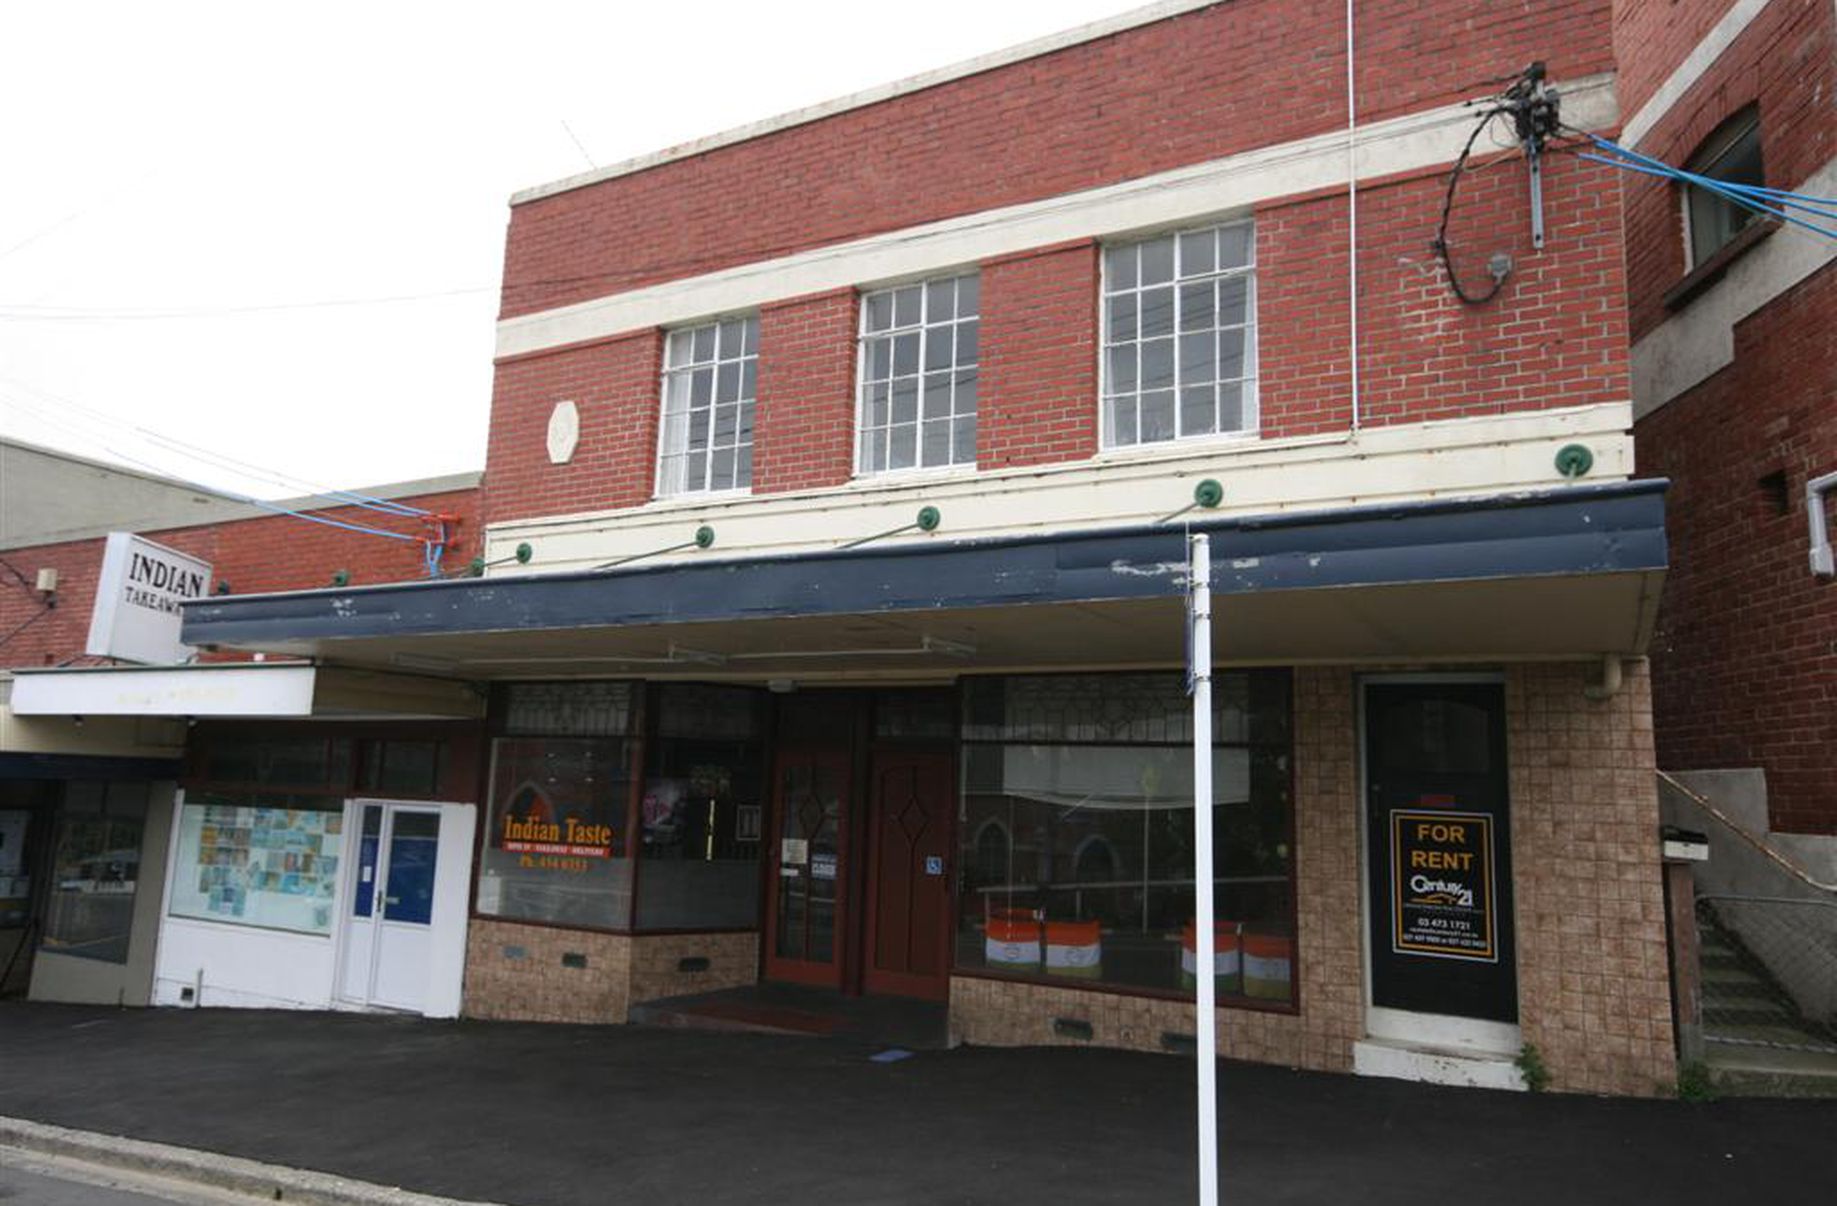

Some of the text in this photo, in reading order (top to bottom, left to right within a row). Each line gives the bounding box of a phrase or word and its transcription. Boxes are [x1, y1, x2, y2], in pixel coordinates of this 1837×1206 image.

[129, 552, 204, 598] INDIAN
[504, 815, 612, 845] Indian Taste
[1417, 824, 1466, 843] FOR
[1411, 850, 1474, 871] RENT
